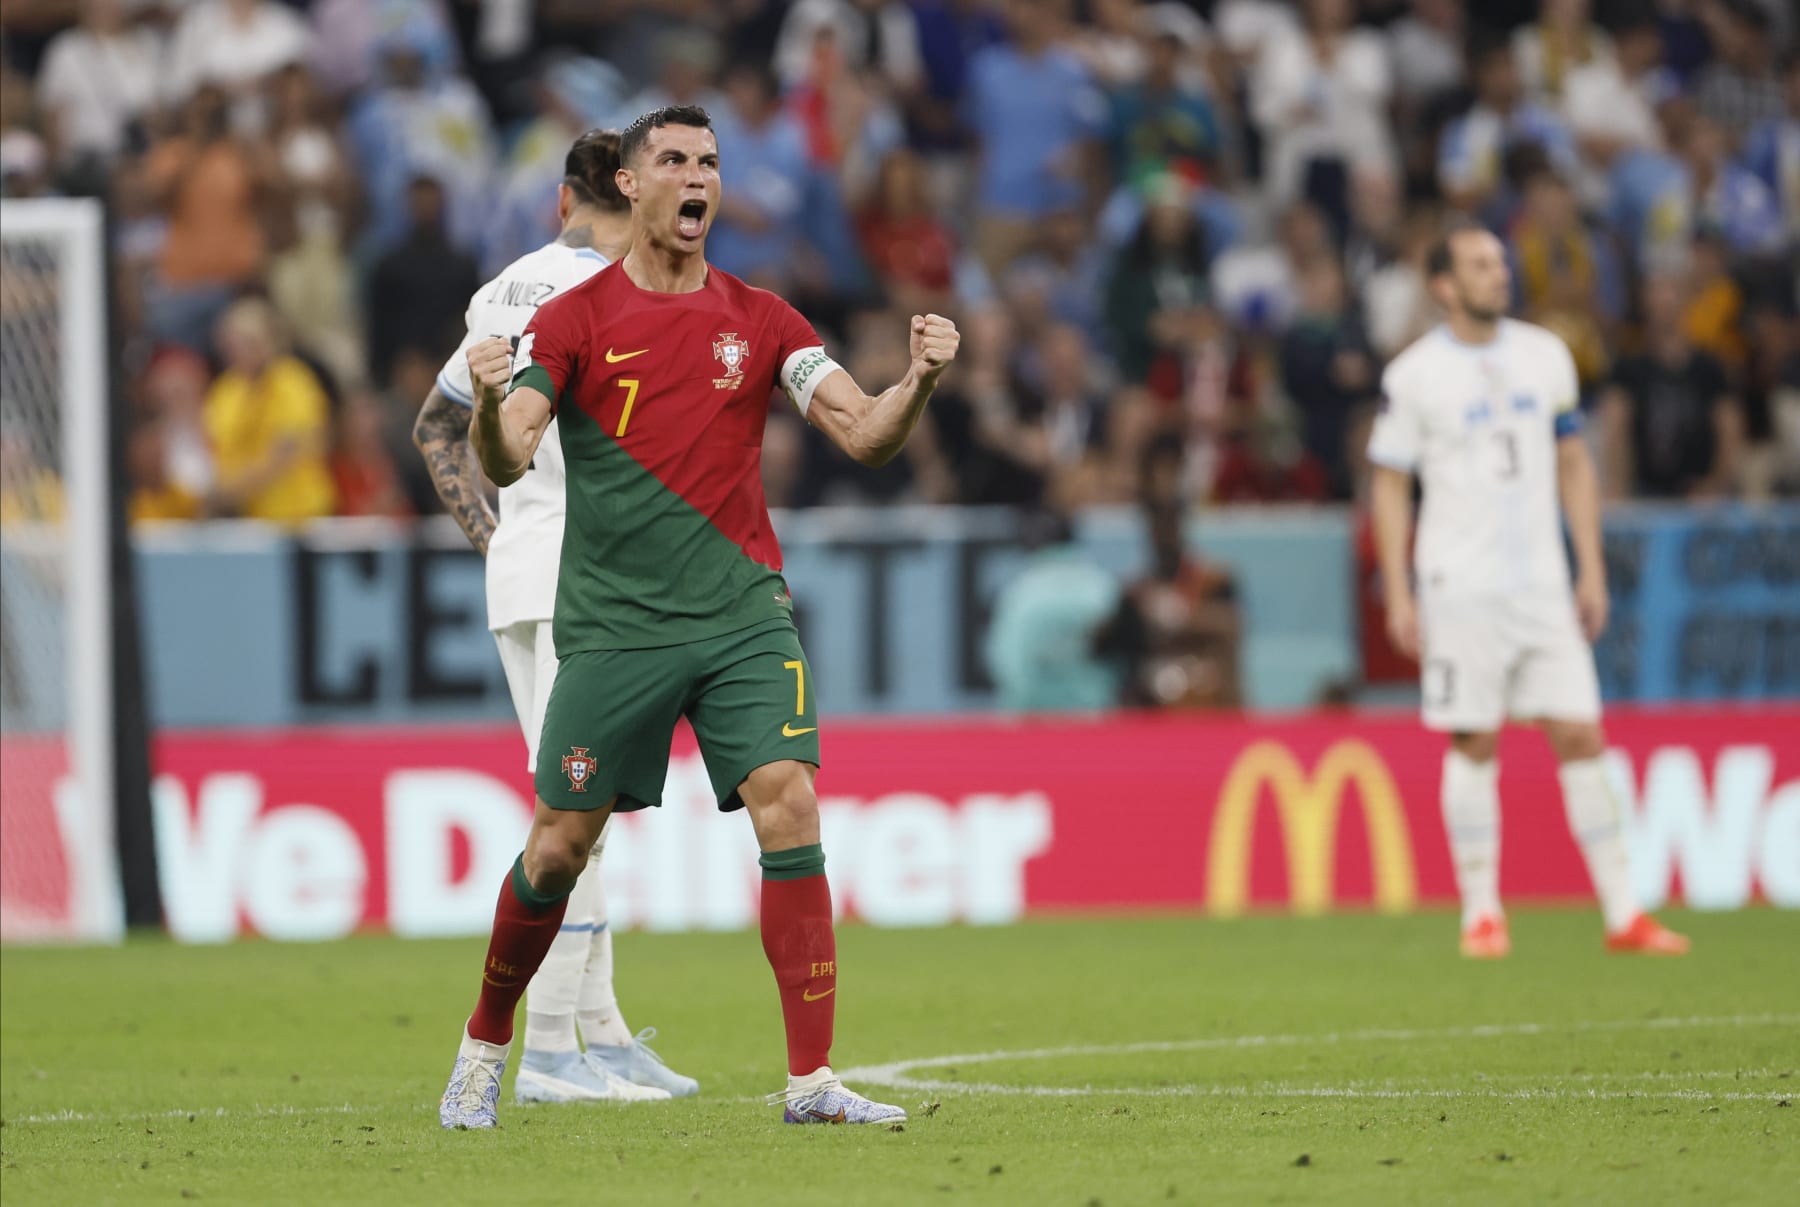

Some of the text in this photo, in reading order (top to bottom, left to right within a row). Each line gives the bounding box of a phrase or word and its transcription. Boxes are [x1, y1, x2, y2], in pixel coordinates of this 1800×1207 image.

[790, 357, 811, 385] SAVE
[616, 379, 639, 437] 7
[1491, 429, 1521, 481] 3
[784, 660, 804, 716] 7
